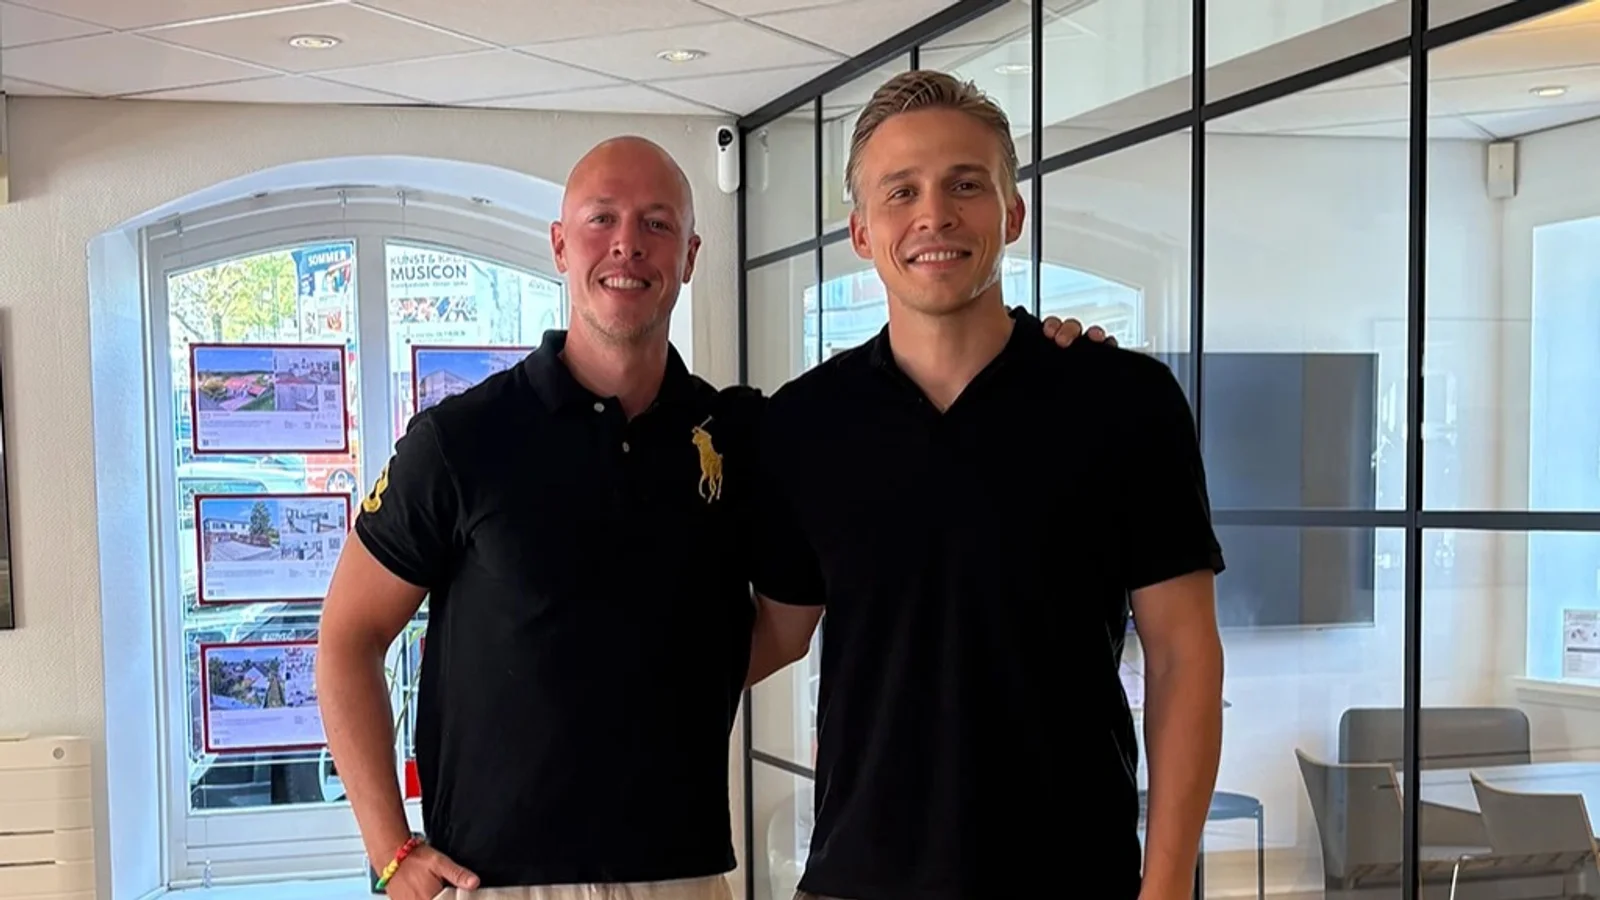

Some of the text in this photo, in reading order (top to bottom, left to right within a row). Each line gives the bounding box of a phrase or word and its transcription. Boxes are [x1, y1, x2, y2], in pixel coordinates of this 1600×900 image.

[307, 249, 347, 267] SOMMER
[390, 254, 426, 265] KUNST
[428, 254, 436, 265] &
[390, 265, 467, 281] MUSICON
